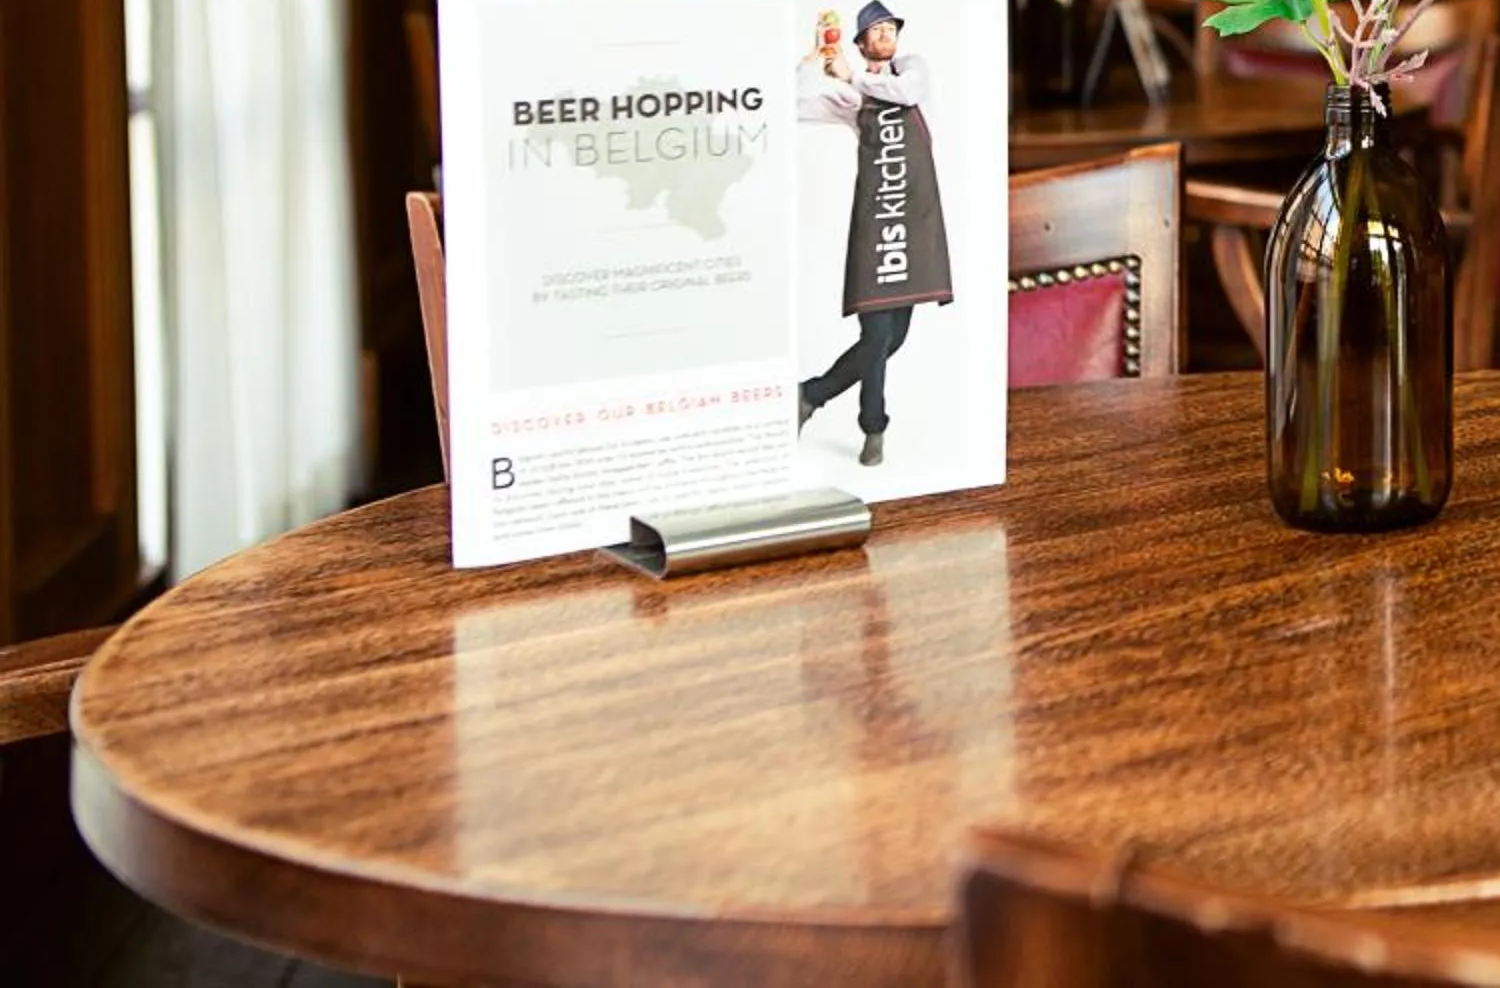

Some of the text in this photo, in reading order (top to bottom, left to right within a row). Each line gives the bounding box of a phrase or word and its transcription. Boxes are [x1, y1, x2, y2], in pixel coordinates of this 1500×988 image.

[513, 87, 763, 125] BEER HOPPING
[508, 122, 768, 169] IN BELGIUM
[873, 106, 908, 284] ibis kitchen
[490, 384, 784, 435] DISCOVER OUR BELGIAN BEERS
